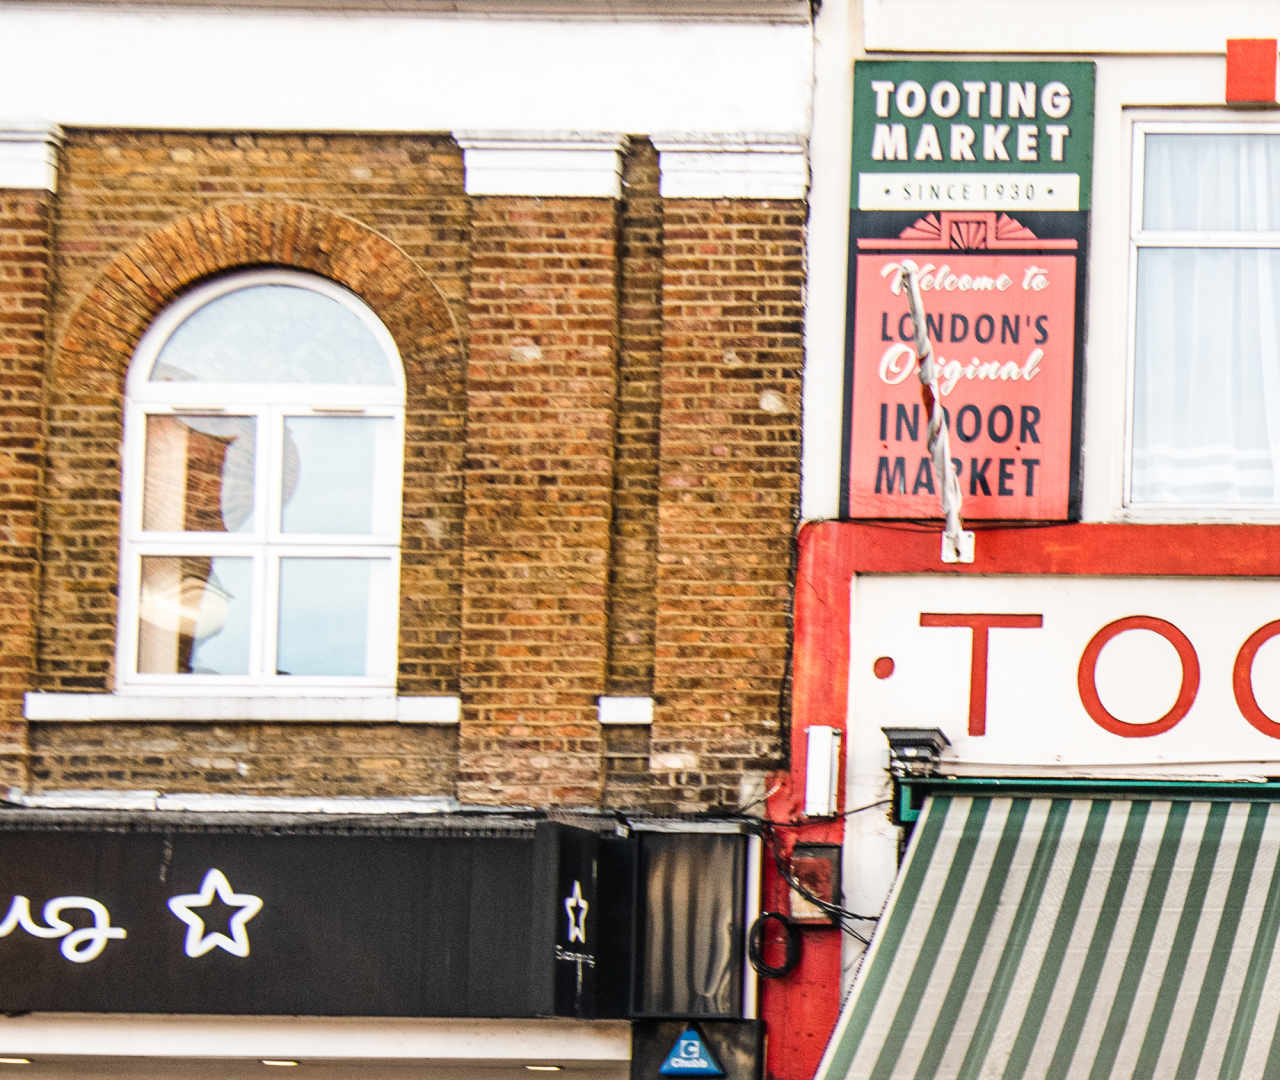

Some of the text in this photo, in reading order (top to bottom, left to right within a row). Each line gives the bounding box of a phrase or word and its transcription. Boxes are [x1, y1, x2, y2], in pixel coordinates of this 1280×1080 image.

[871, 80, 1072, 118] TOOTING
[871, 123, 1070, 161] MARKET
[903, 183, 1035, 201] SINCE 1930
[1022, 265, 1049, 291] to
[879, 343, 1044, 396] Oiginal
